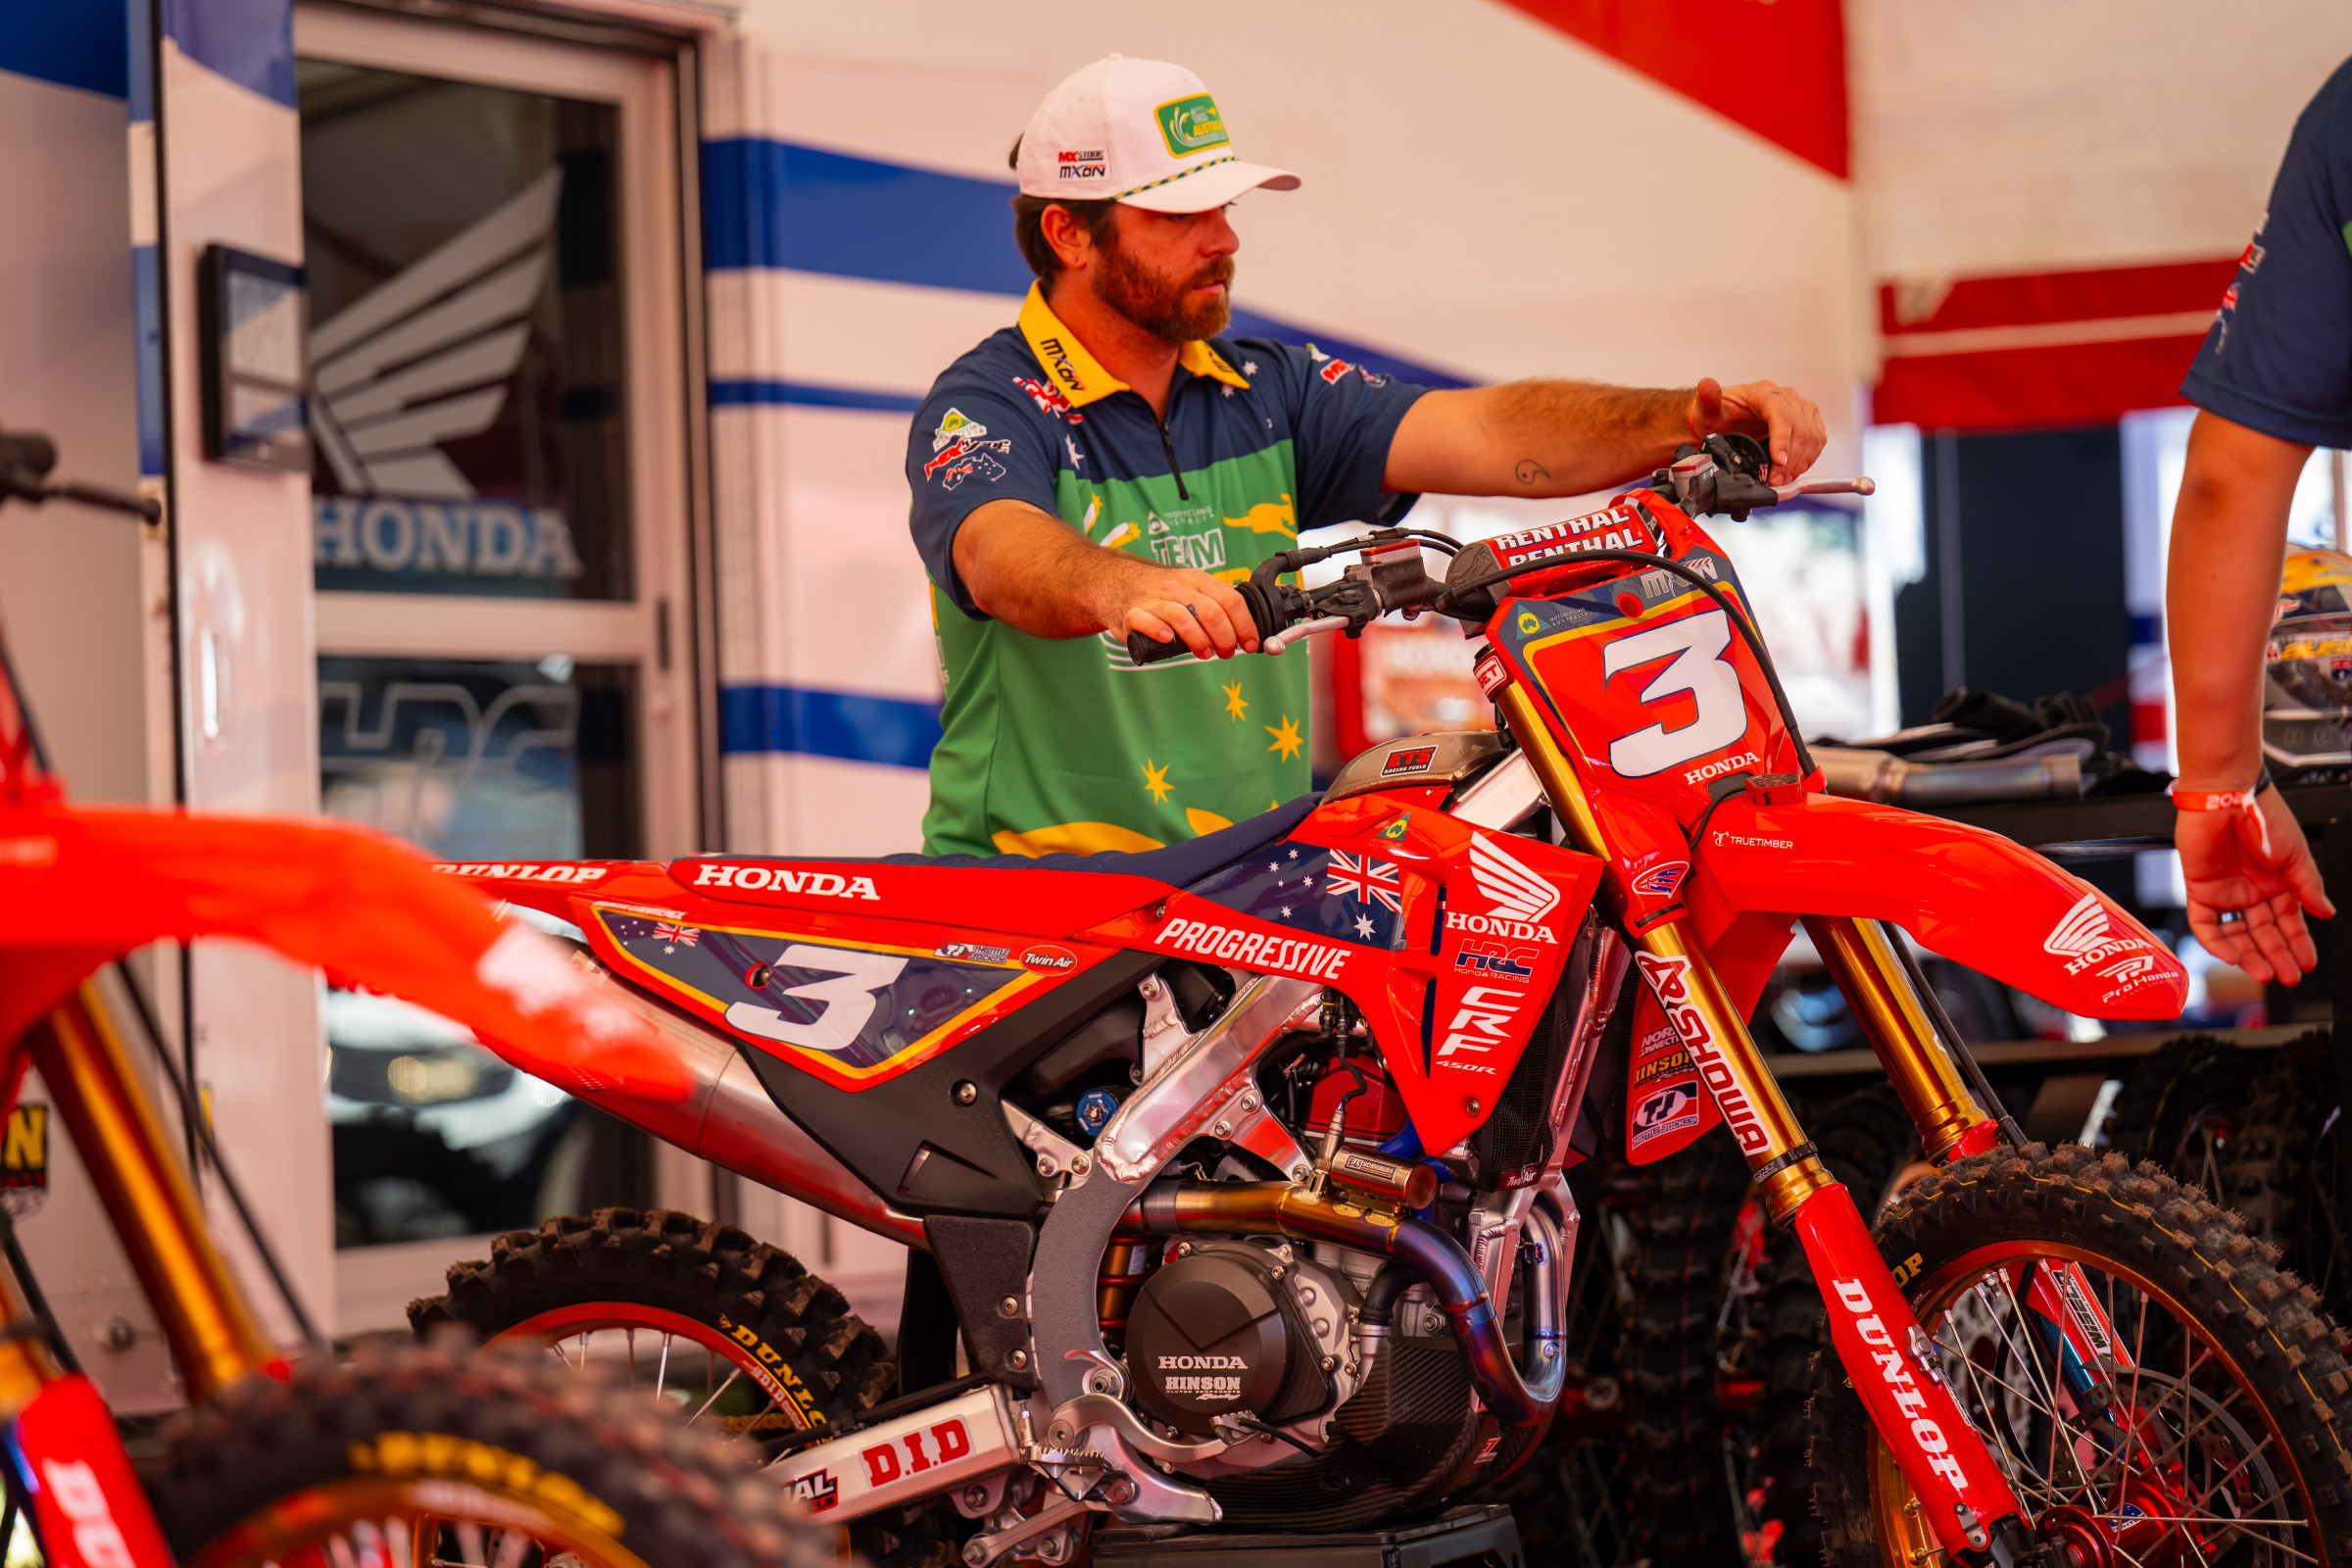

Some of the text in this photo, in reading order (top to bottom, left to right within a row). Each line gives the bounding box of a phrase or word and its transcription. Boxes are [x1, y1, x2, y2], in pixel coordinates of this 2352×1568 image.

[313, 498, 586, 580] HONDA
[1494, 509, 1631, 551] RENTHAL
[1151, 527, 1226, 570] TEAM
[1603, 609, 1748, 778] 3
[1384, 765, 1408, 774] RACING
[1388, 749, 1434, 767] ETS
[1684, 752, 1761, 785] HONDA
[1730, 836, 1793, 850] TRUETIMBER
[694, 864, 880, 900] HONDA
[1446, 911, 1558, 944] HONDA
[1024, 953, 1074, 968] Twin Air
[1154, 917, 1351, 979] PROGRESSIVE
[1455, 938, 1540, 977] HRC
[2063, 938, 2154, 976] HONDA
[1454, 967, 1530, 983] Honda RACING
[724, 944, 909, 1052] 3
[2101, 983, 2132, 1004] Pro
[1435, 1060, 1498, 1075] 450R
[1670, 1007, 1769, 1152] SHOWA
[1157, 1355, 1249, 1369] HONDA
[1165, 1376, 1241, 1391] HINSON
[1832, 1278, 1969, 1490] DUNLOP
[862, 1419, 970, 1488] D.I.D
